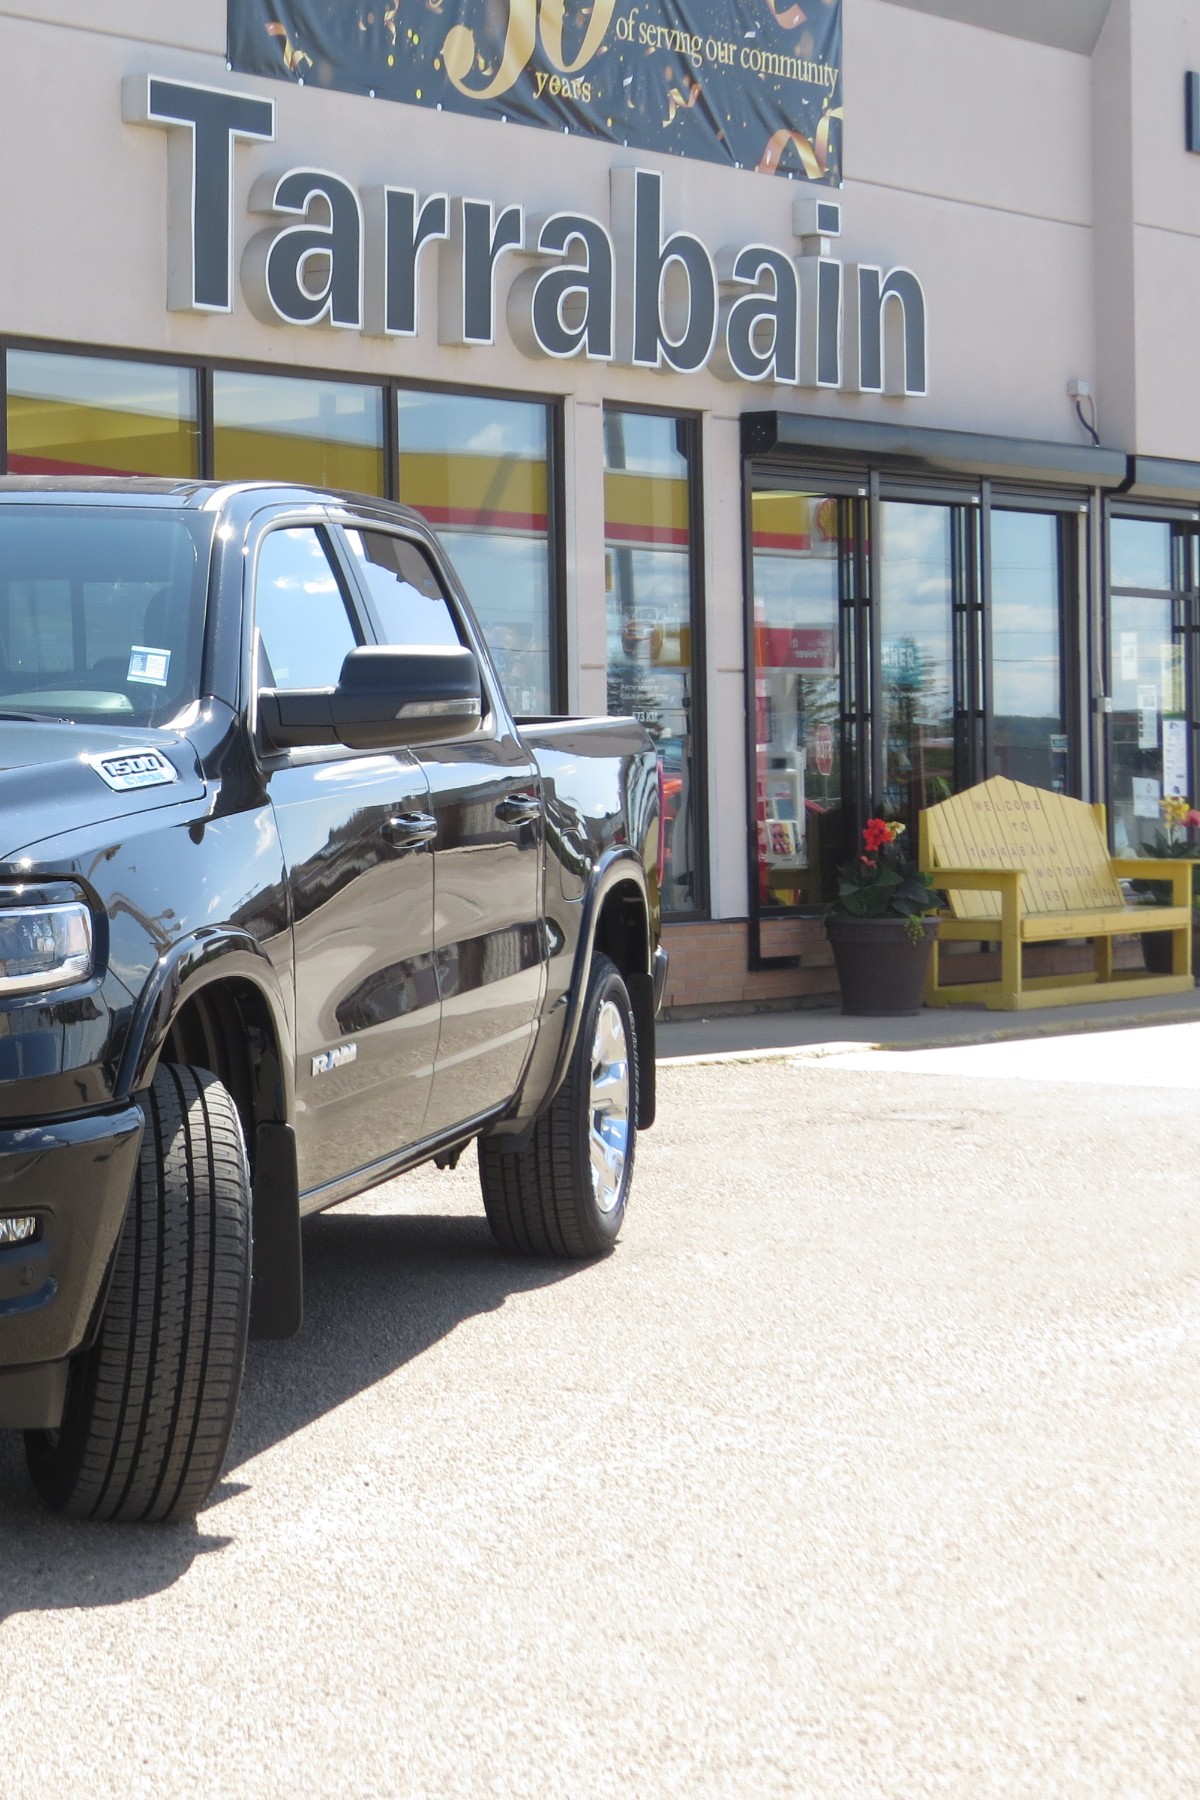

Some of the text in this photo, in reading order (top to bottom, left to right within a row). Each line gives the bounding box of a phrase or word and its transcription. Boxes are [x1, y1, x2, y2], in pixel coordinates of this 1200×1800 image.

[615, 9, 839, 93] of serving our community
[533, 69, 591, 103] years
[145, 74, 928, 397] Tarrabain
[102, 755, 158, 777] 1500
[975, 800, 1040, 812] WELCOME
[1012, 822, 1029, 832] TO
[970, 845, 1057, 858] TARRABAIN
[1036, 866, 1092, 878] MOTORS
[310, 1042, 357, 1077] RAM
